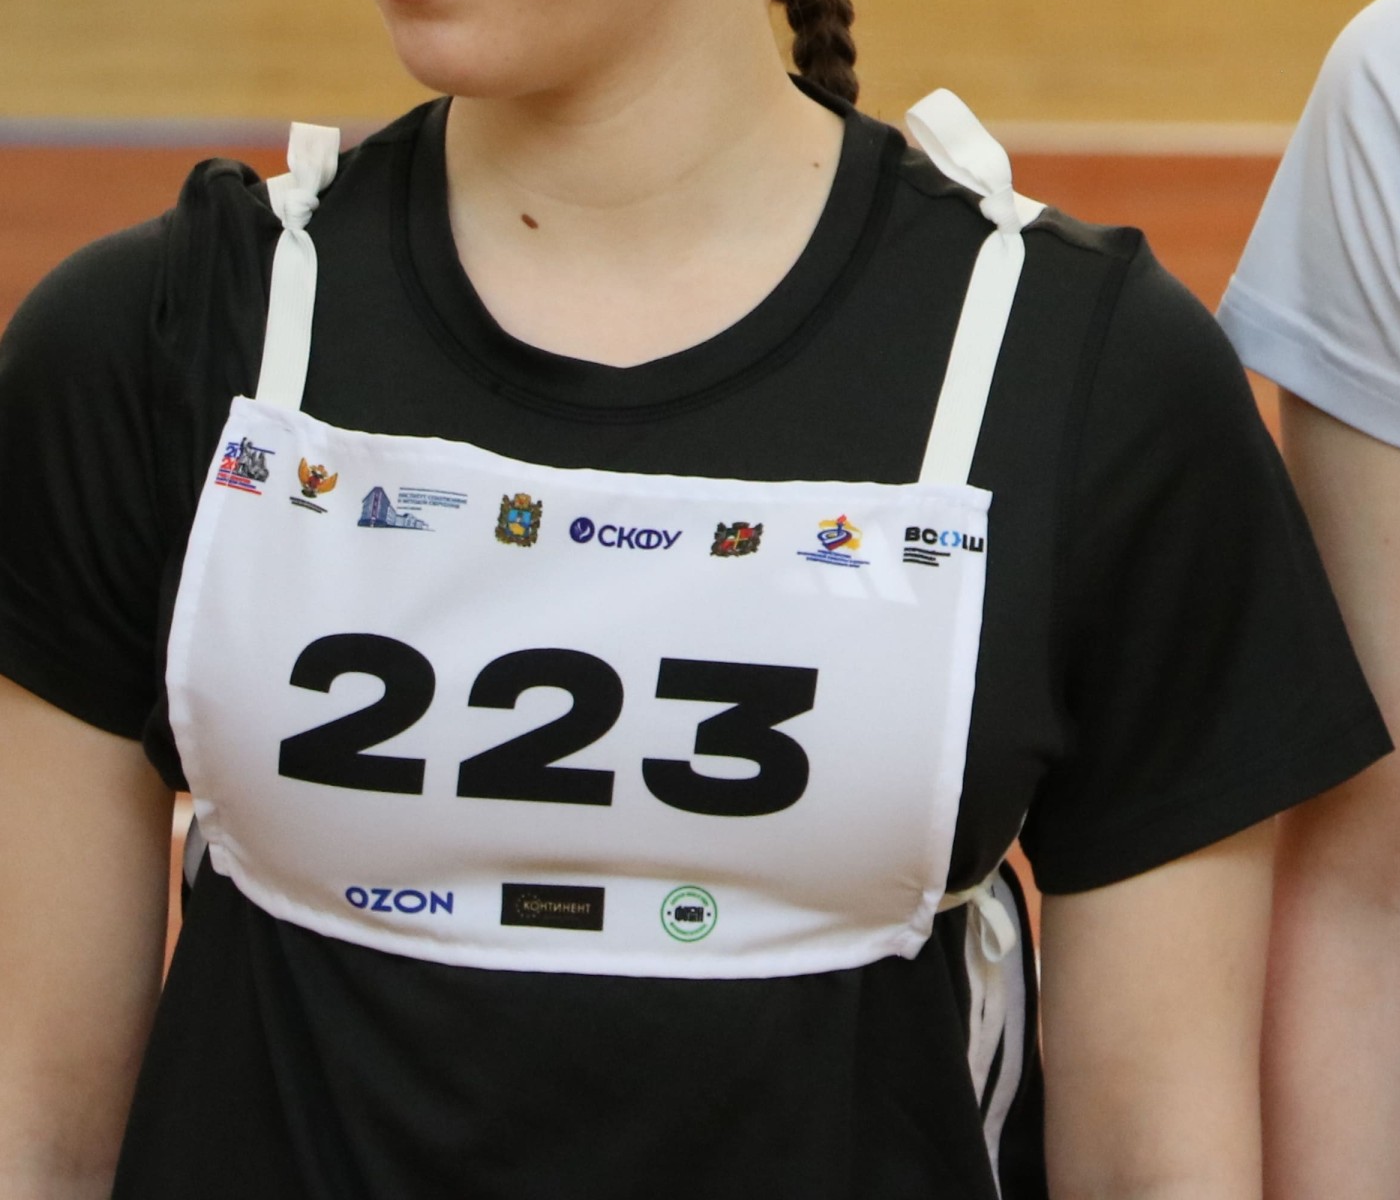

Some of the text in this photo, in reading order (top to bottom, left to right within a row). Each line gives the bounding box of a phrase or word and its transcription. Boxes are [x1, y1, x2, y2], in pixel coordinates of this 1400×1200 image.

[597, 524, 683, 550] СКФУ
[278, 632, 819, 818] 223
[345, 886, 454, 914] OZON
[523, 899, 592, 915] КОНТИНЕНТ
